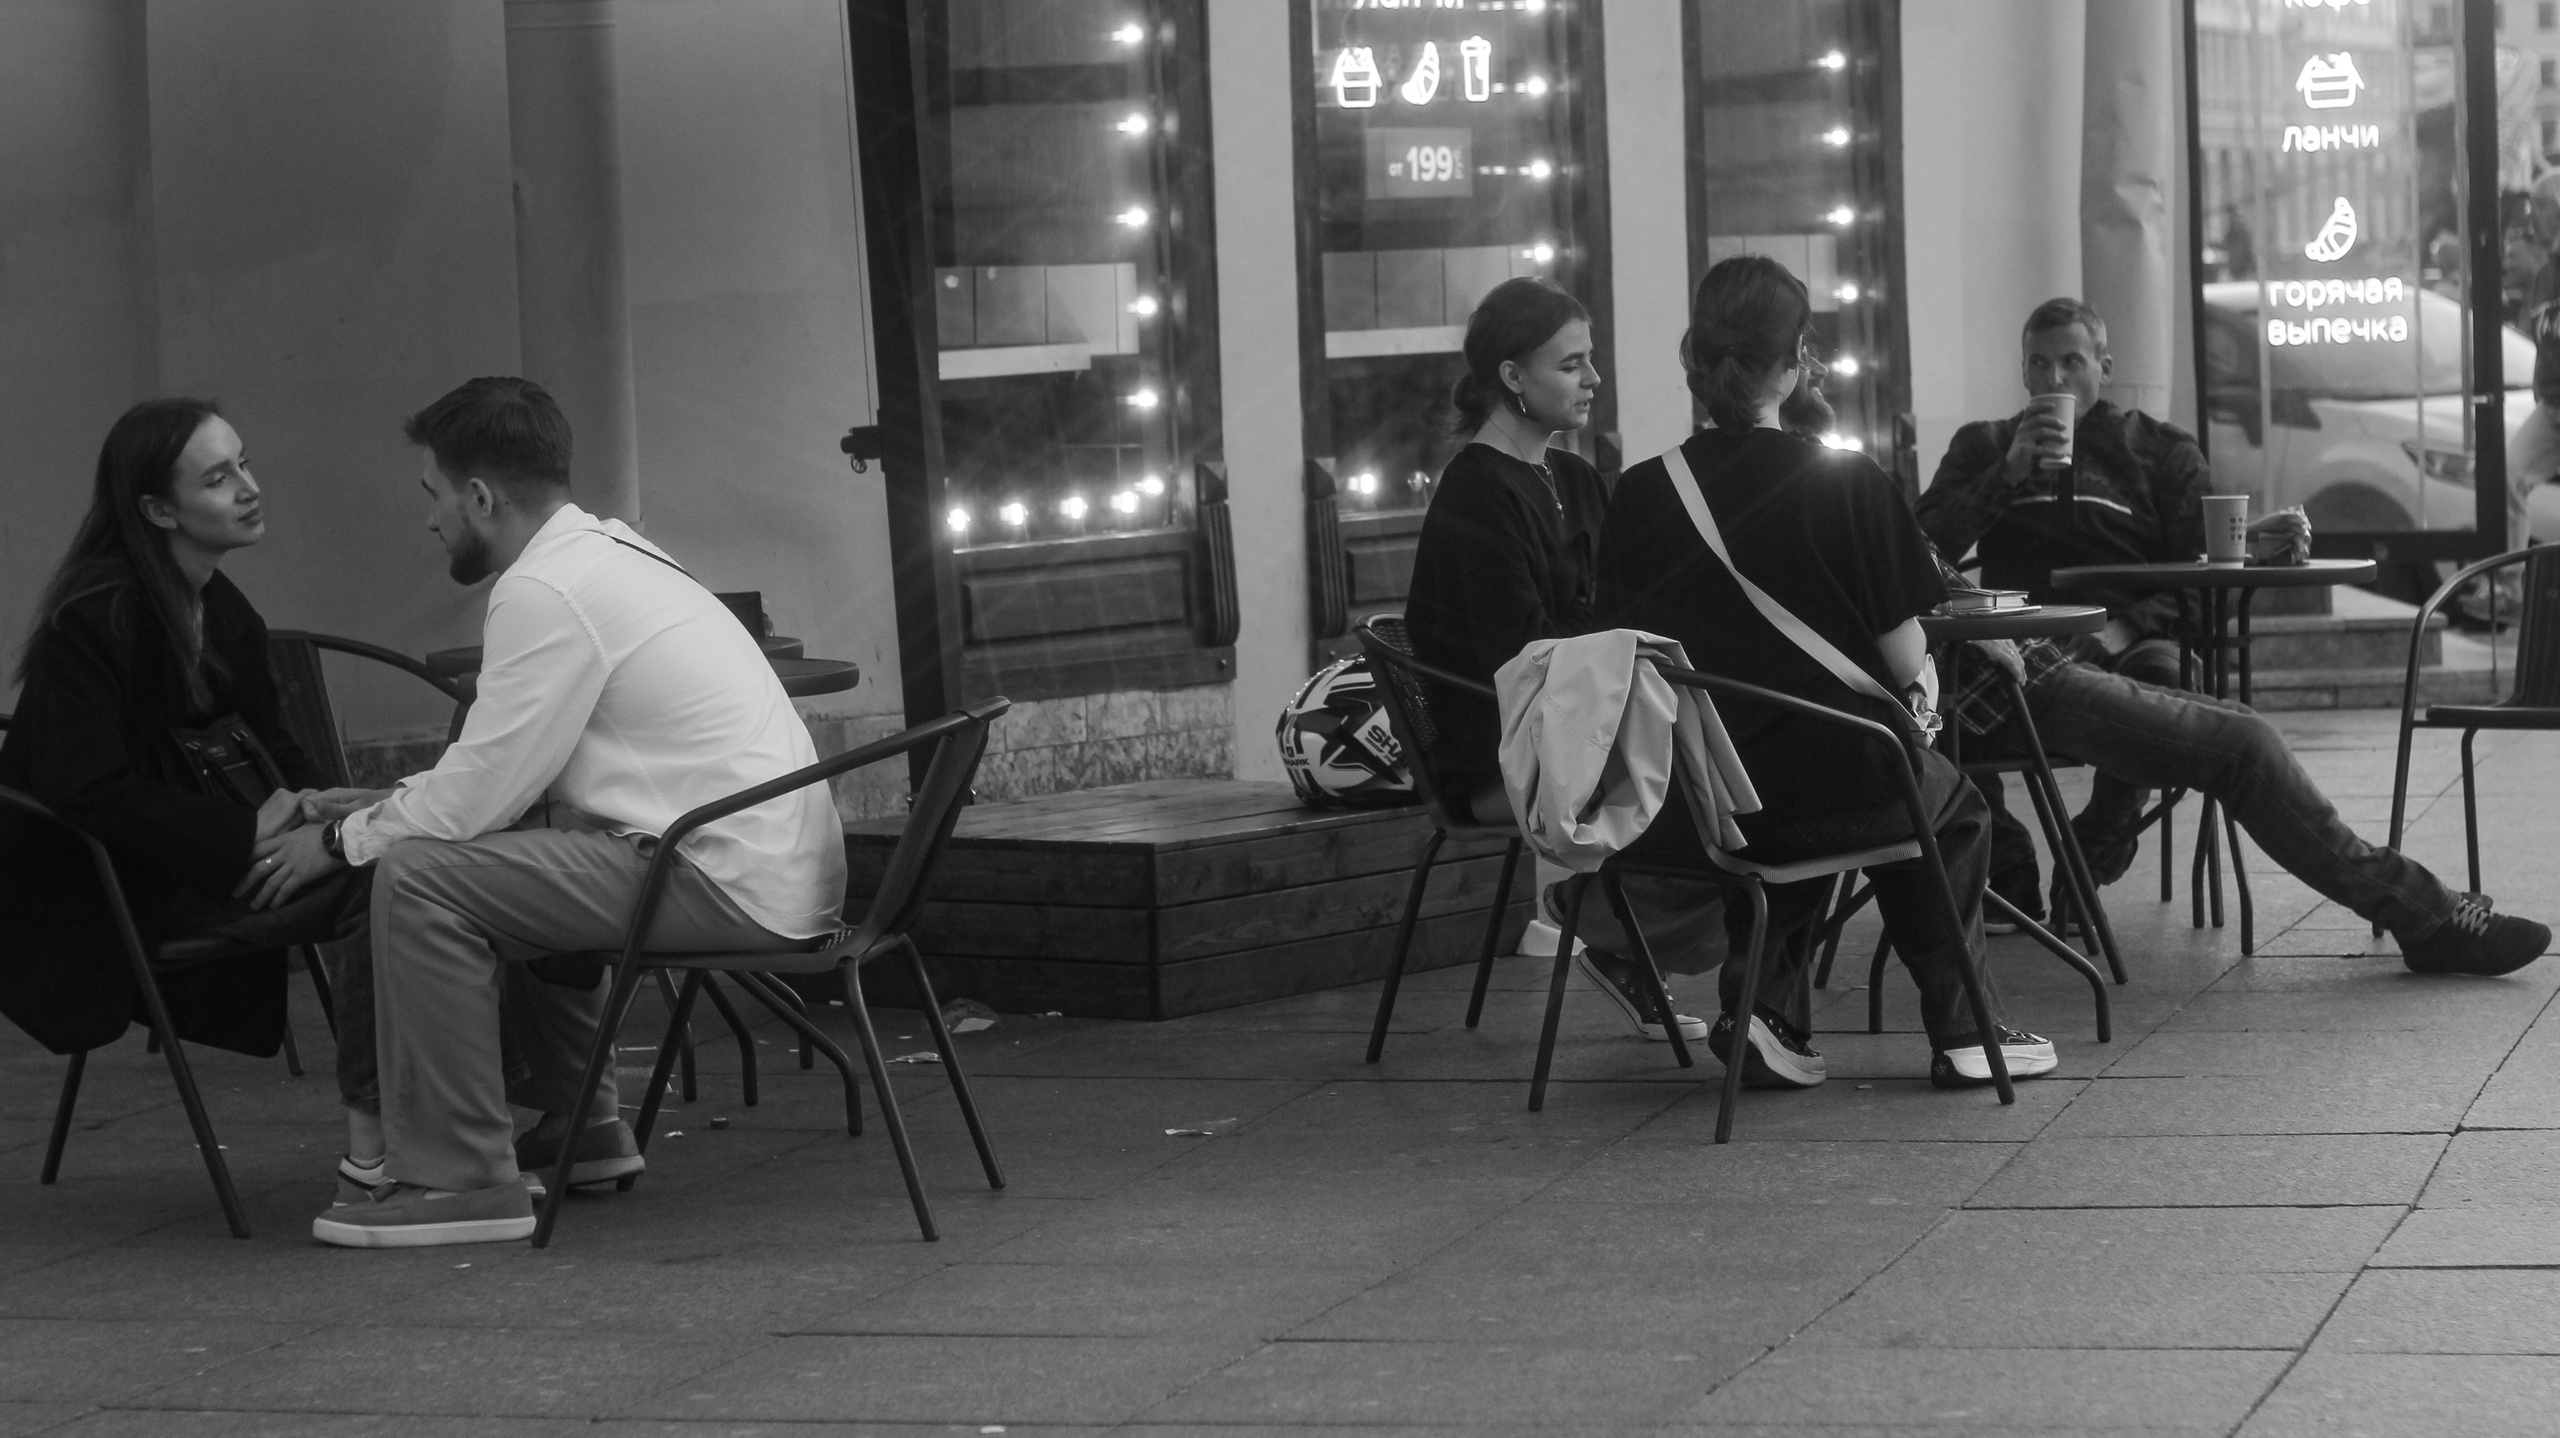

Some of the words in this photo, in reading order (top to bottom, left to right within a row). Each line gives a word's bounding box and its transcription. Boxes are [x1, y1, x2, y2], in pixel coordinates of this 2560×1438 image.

[2281, 124, 2380, 153] ланчи
[1406, 145, 1453, 182] 199
[2269, 277, 2403, 312] горячая
[2267, 315, 2408, 346] выпечка
